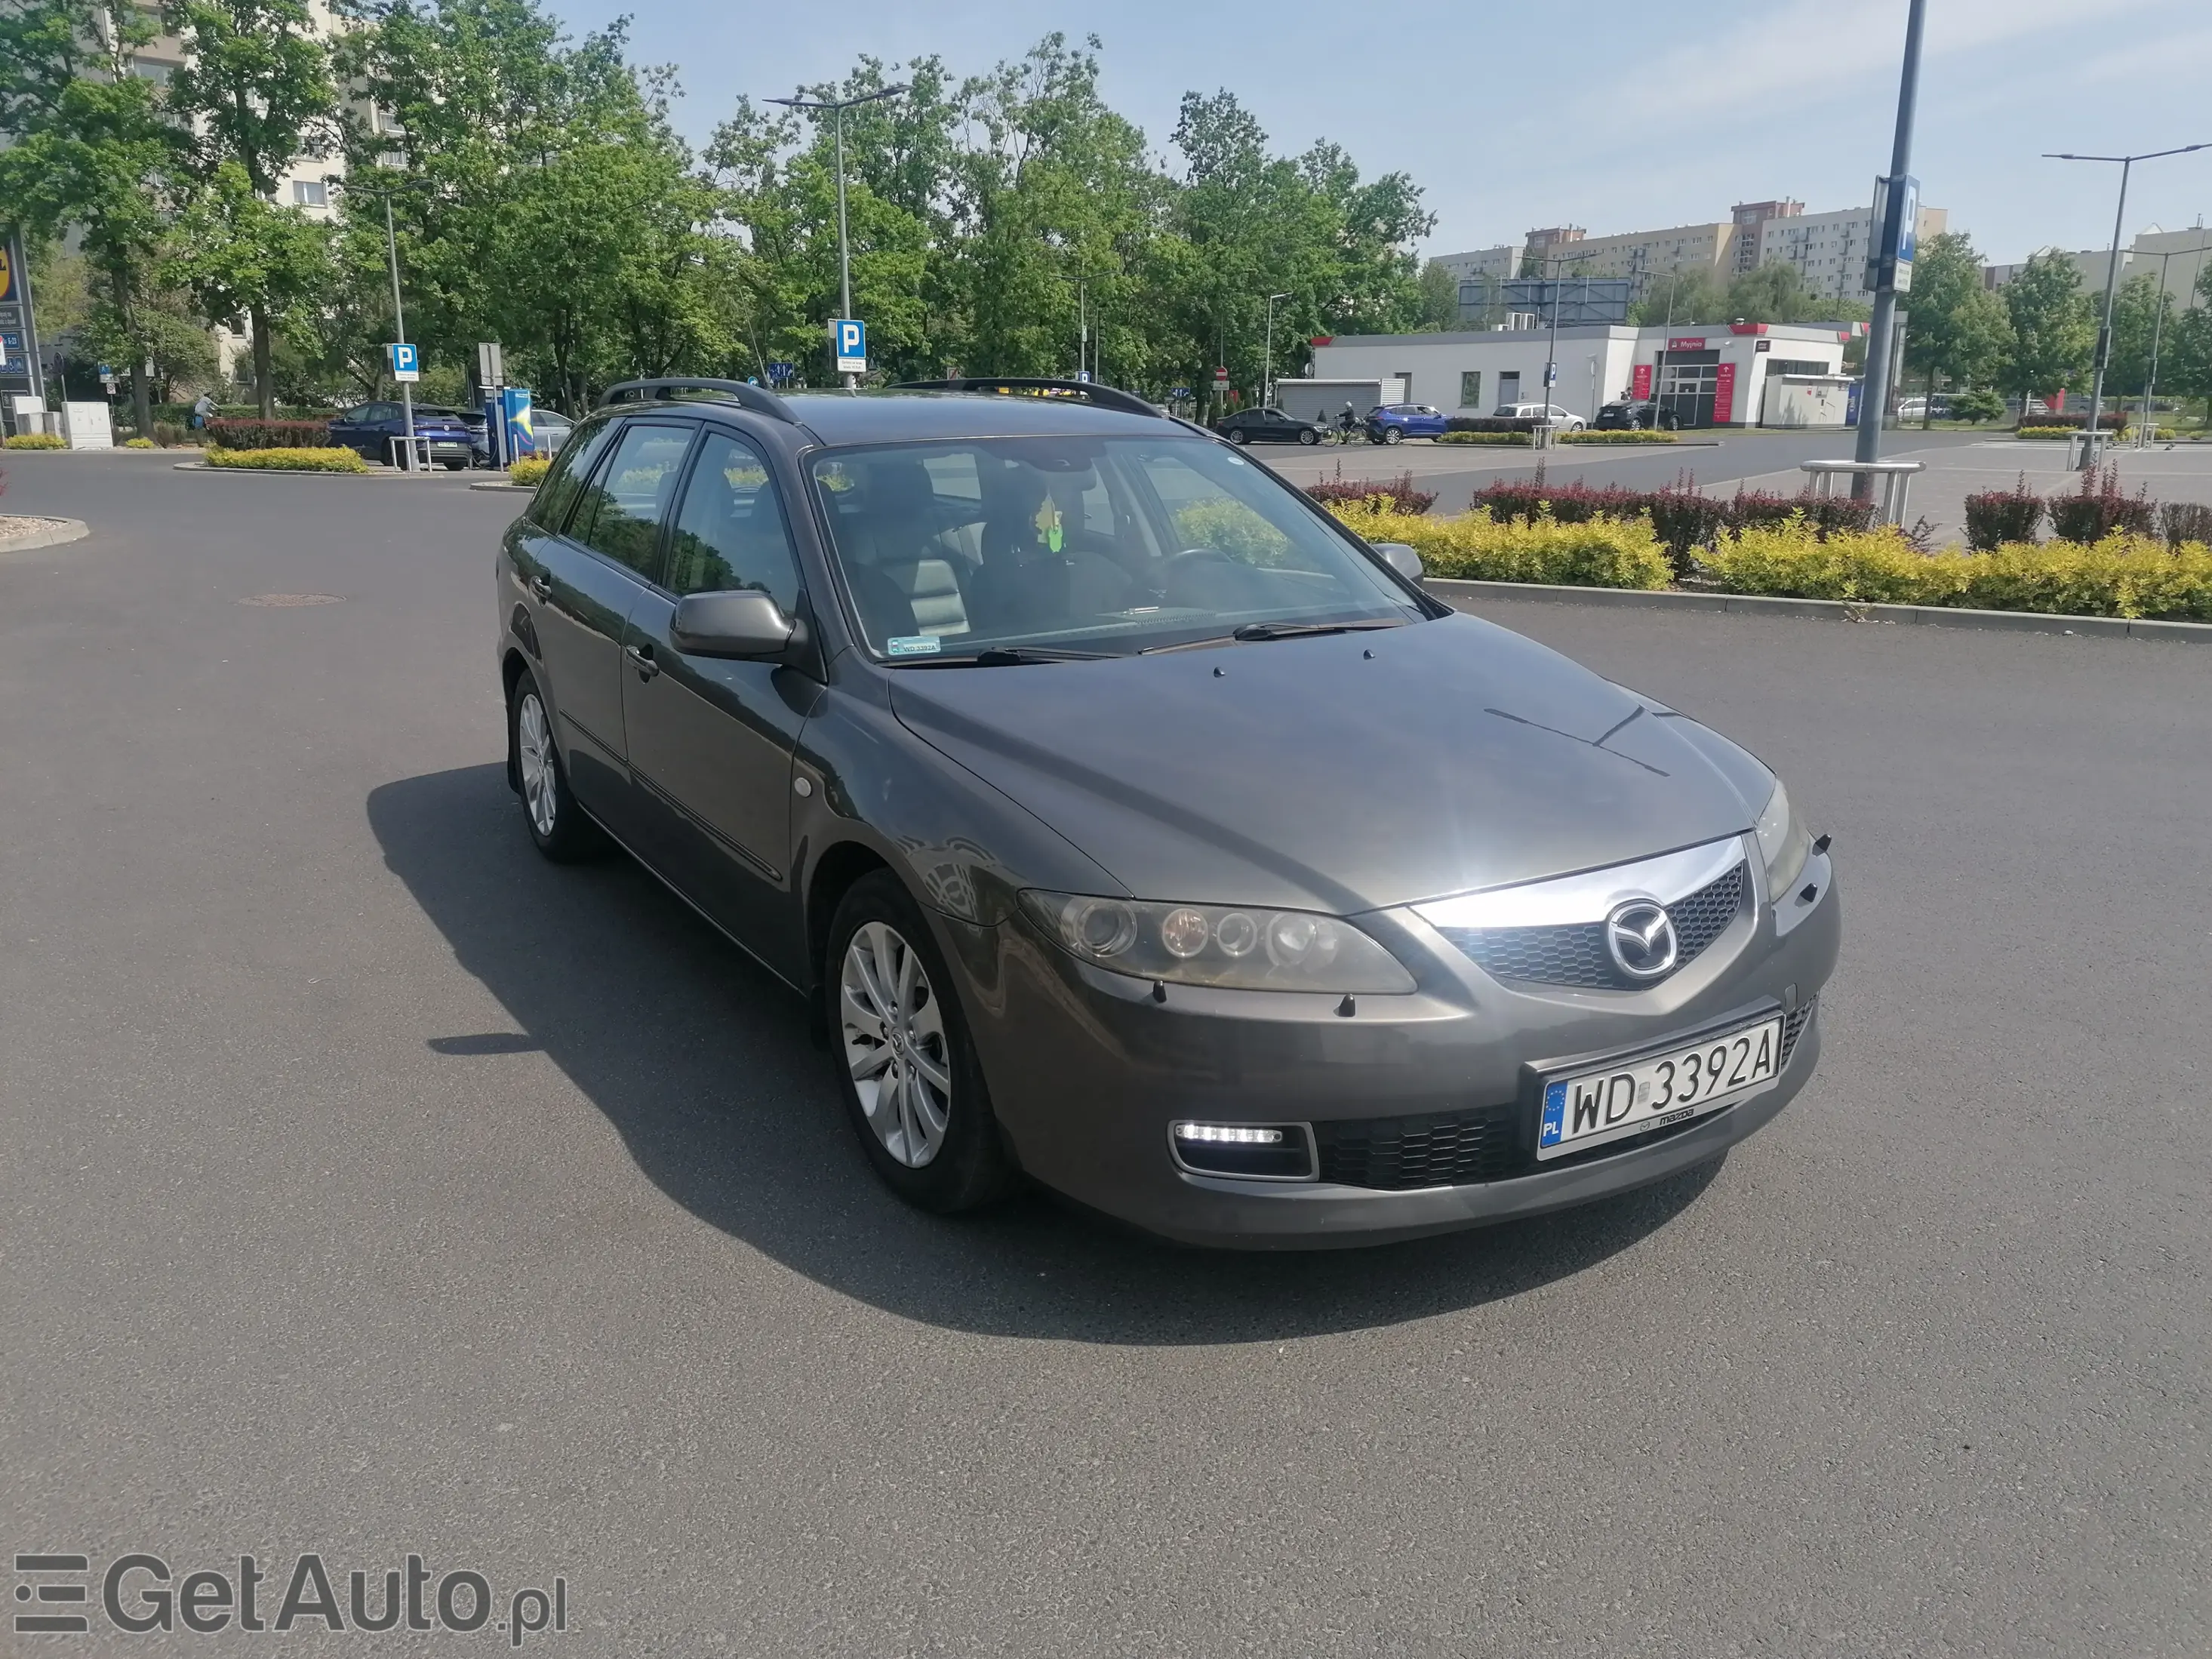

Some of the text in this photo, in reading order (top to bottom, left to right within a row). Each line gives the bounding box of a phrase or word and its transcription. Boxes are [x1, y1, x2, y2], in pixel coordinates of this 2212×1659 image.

[1902, 185, 1916, 251] P
[843, 325, 860, 353] P
[1680, 340, 1703, 349] Myjnia
[397, 346, 413, 368] P
[1551, 364, 1556, 379] P
[1543, 1029, 1771, 1137] PL WD 3392A
